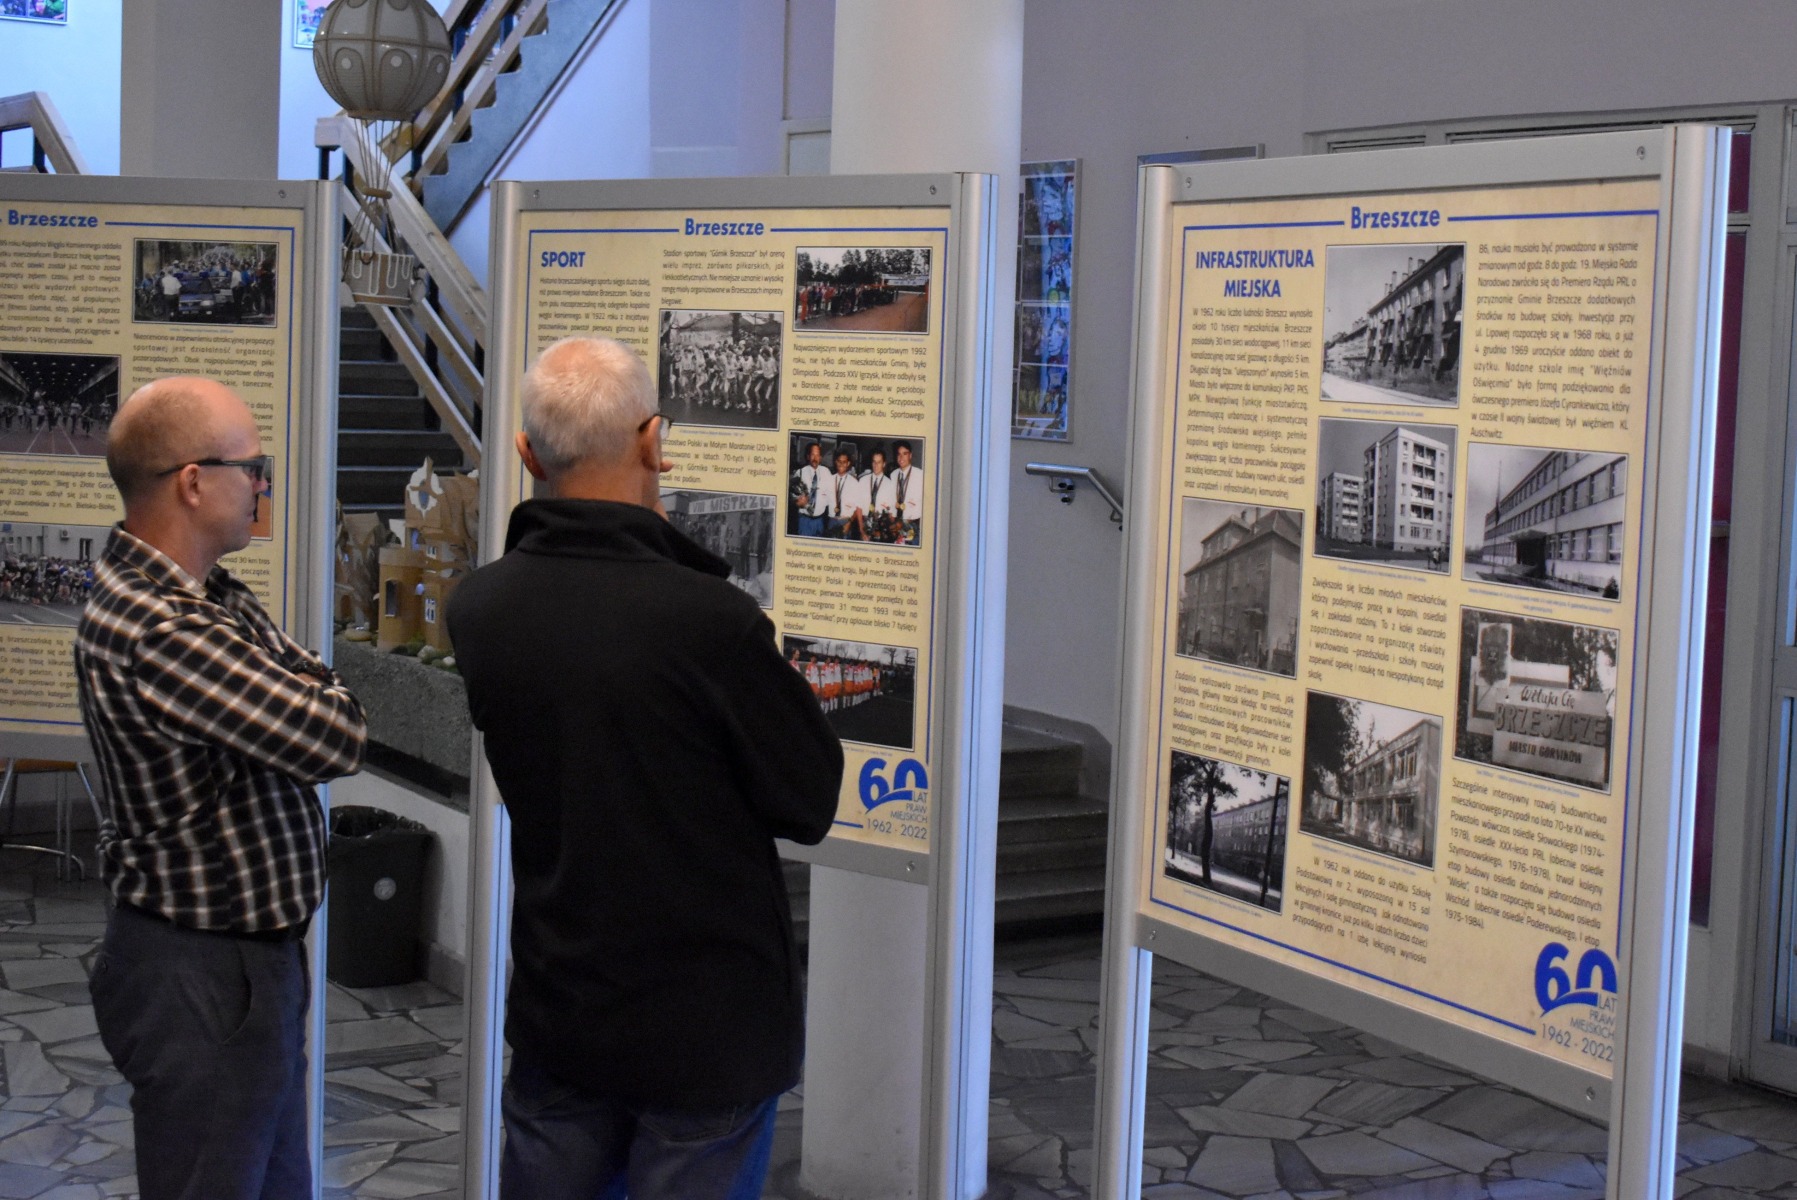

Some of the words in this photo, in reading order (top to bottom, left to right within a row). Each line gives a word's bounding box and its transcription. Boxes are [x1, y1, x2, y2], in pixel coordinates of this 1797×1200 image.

[8, 210, 98, 227] Brzeszcze
[1350, 206, 1440, 229] Brzeszcze
[685, 218, 764, 236] Brzeszcze
[541, 251, 586, 268] SPORT
[1196, 250, 1314, 268] INFRASTRUKTURA
[1224, 280, 1281, 298] MIEJSKA
[1518, 294, 1542, 304] Gminie
[1547, 294, 1581, 304] Brzeszcze
[1587, 294, 1635, 307] dodatkowych
[1620, 314, 1634, 325] przy
[1574, 329, 1591, 340] 1968
[912, 347, 926, 355] 1992
[1512, 345, 1528, 355] 1969
[913, 792, 928, 803] LAT
[867, 818, 892, 834] 1962
[901, 824, 927, 839] 2022
[1598, 995, 1617, 1012] LAT
[1541, 1023, 1571, 1048] 1962
[1582, 1038, 1614, 1062] 2022
